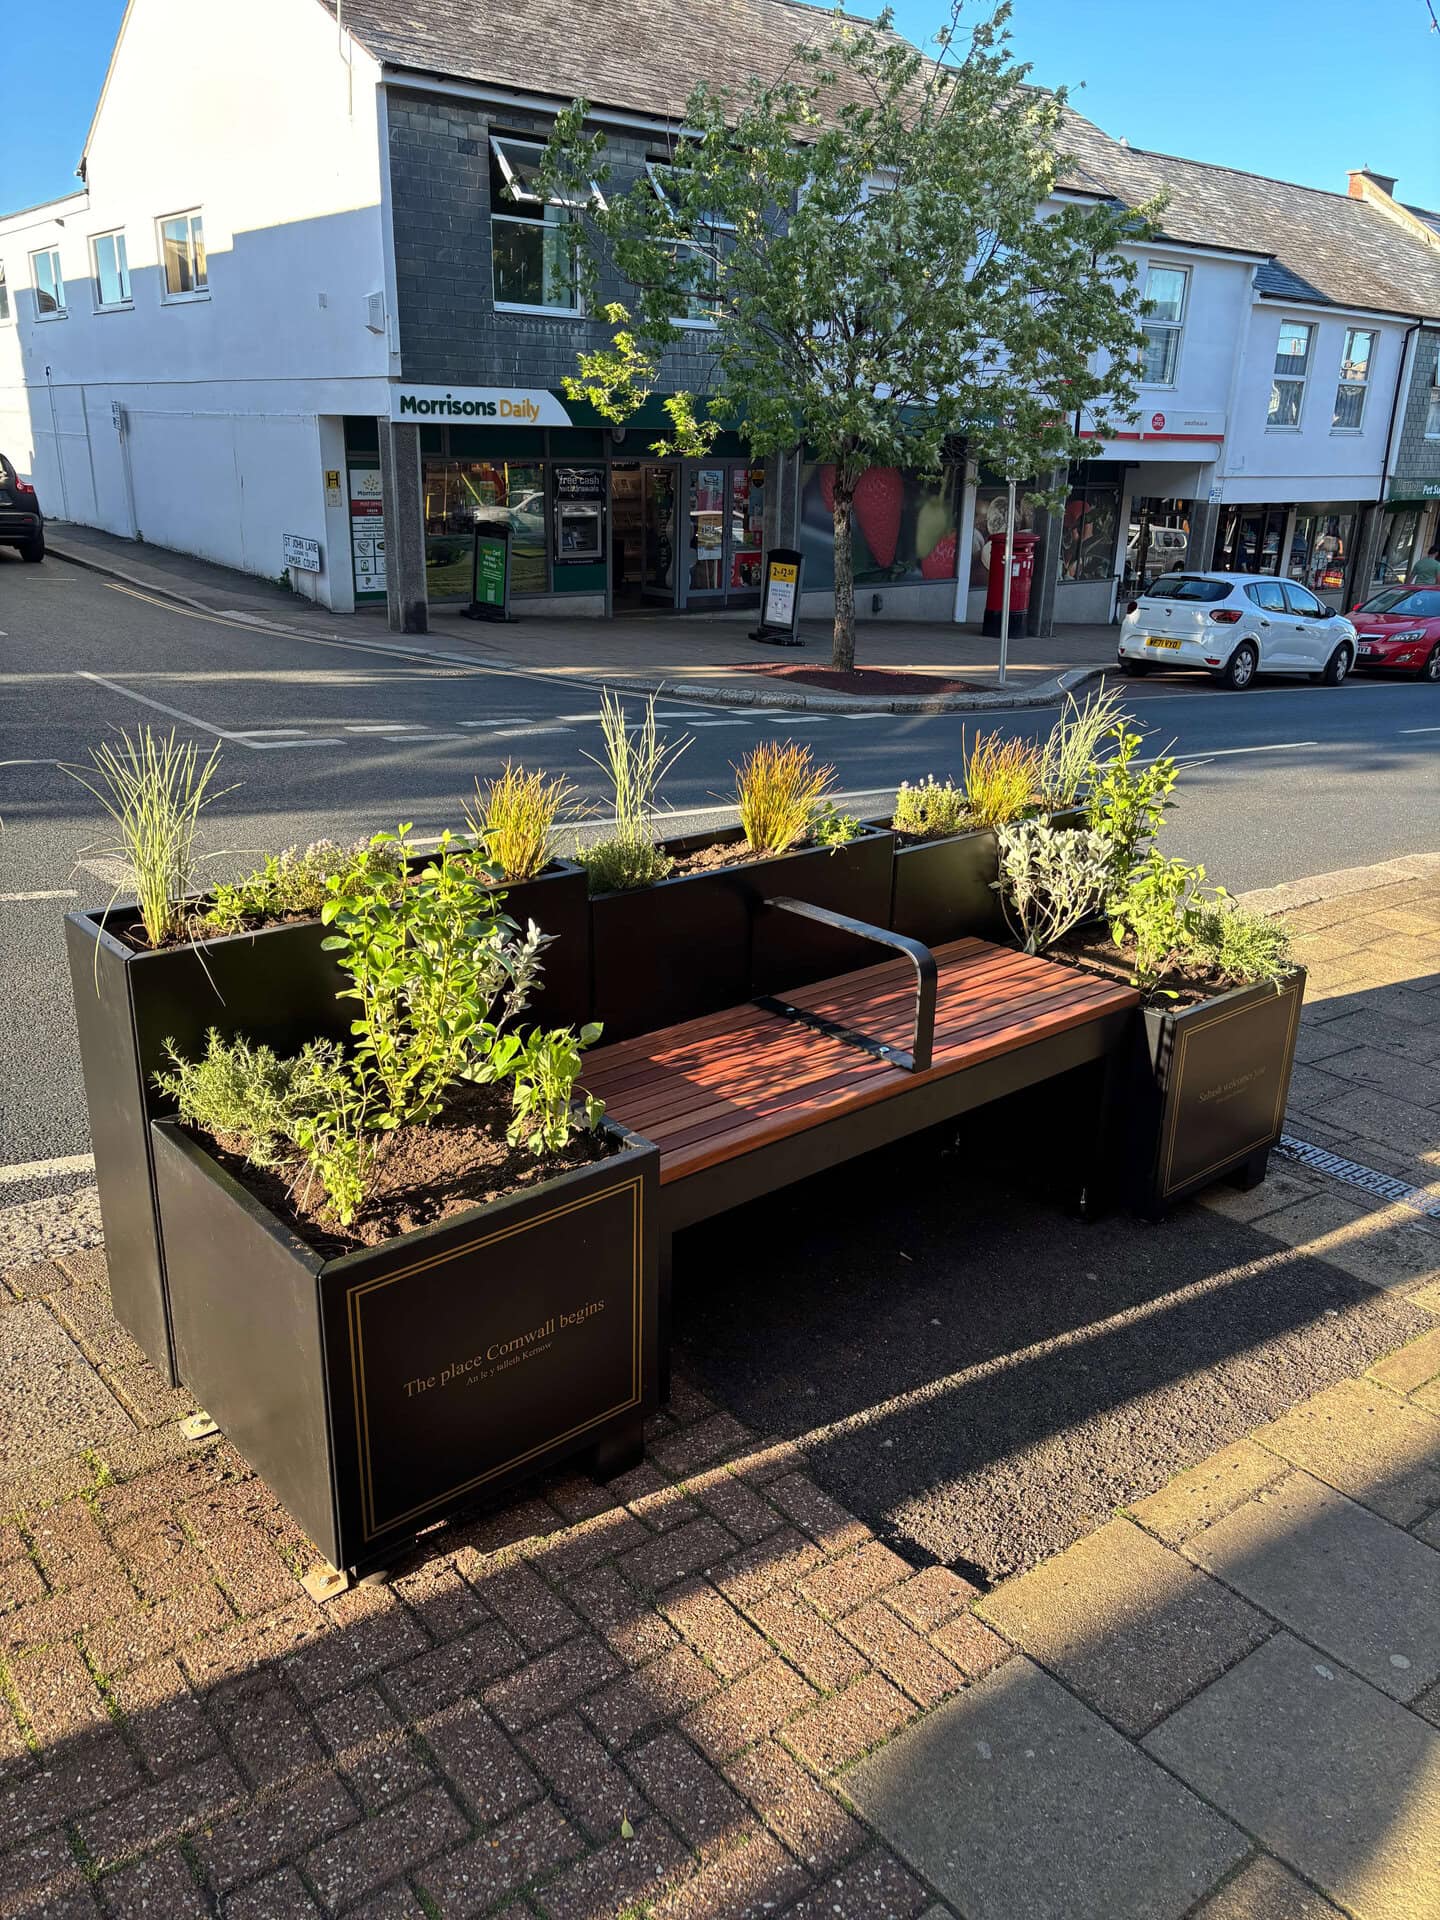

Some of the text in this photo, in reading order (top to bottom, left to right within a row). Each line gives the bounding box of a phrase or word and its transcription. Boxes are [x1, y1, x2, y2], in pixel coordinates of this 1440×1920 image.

[400, 393, 540, 423] Morrisons Daily
[328, 470, 339, 489] H
[560, 474, 600, 485] free cash
[1423, 484, 1433, 496] Pet
[403, 1299, 605, 1397] The place Cornwall begins
[465, 1375, 479, 1386] An
[488, 1367, 495, 1377] y
[521, 1341, 553, 1360] Kernow
